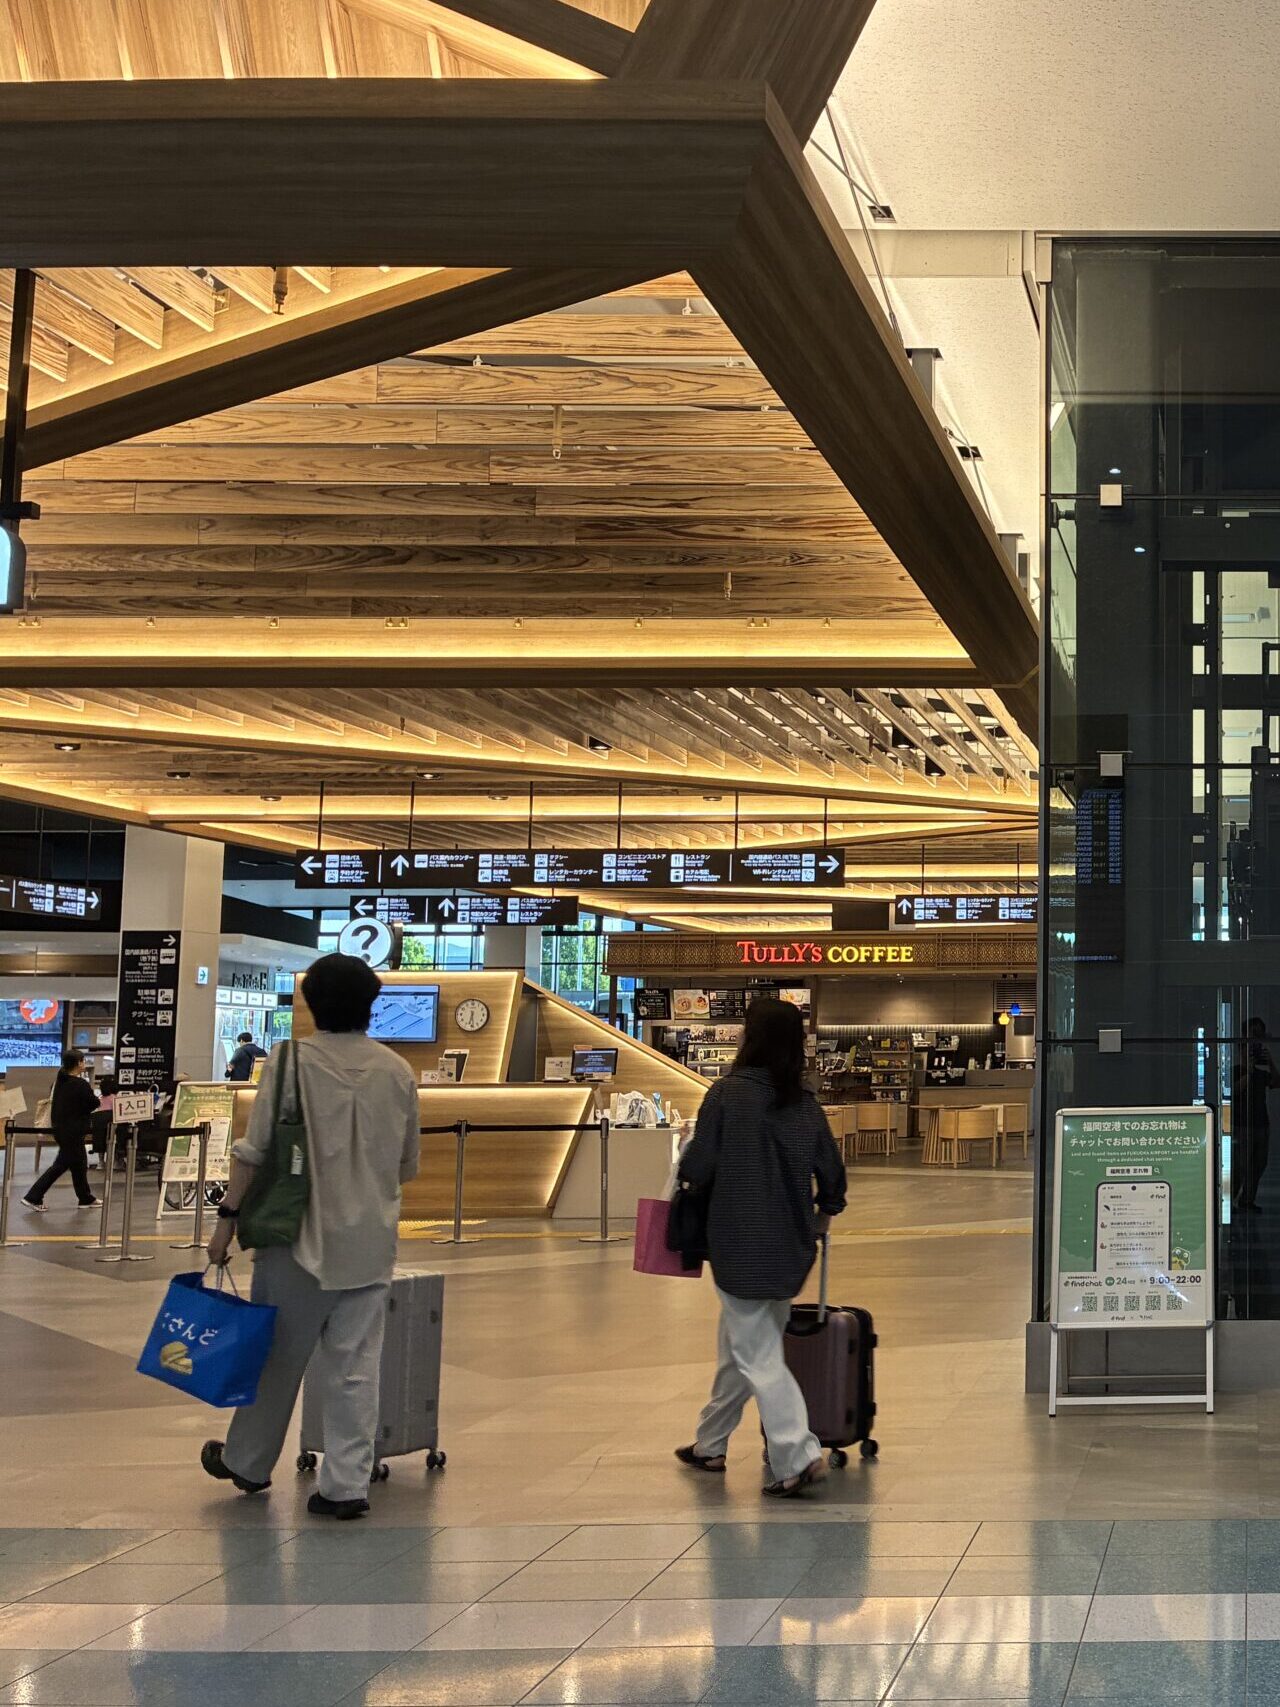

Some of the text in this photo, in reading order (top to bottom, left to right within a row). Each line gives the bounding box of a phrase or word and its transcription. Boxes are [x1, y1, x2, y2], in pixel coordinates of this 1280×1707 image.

[827, 946, 914, 963] COFFEE
[125, 1099, 146, 1111] 入口
[1082, 1120, 1187, 1132] 福岡空港でのお忘れ物は
[1069, 1136, 1201, 1147] チャットでお問い合わせください
